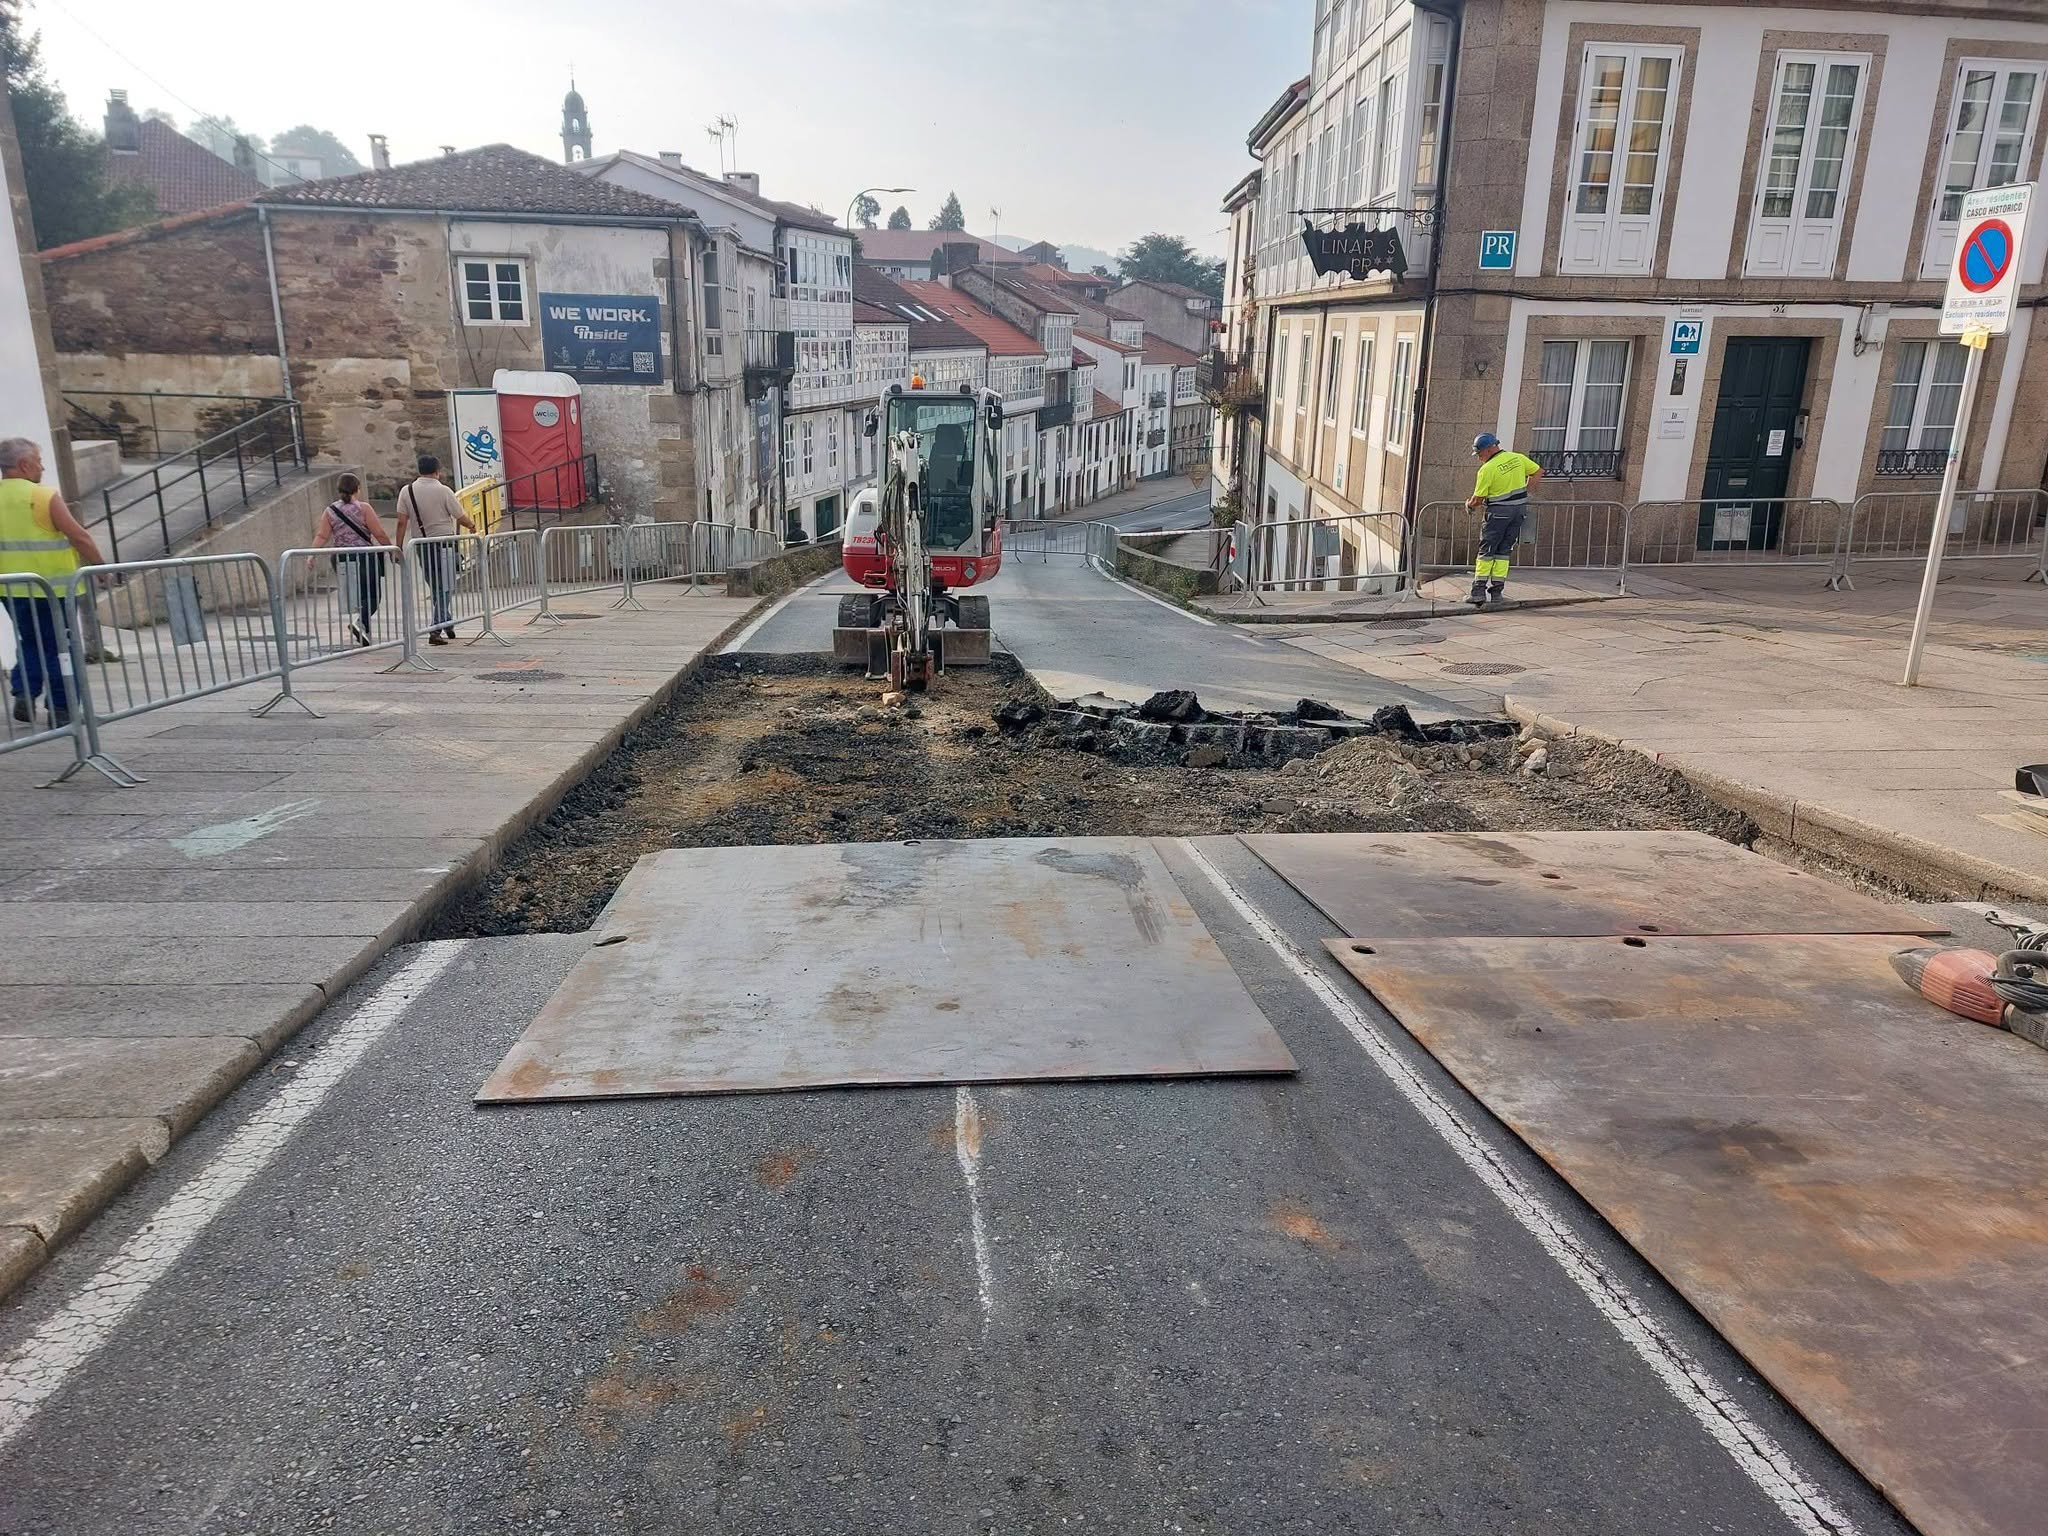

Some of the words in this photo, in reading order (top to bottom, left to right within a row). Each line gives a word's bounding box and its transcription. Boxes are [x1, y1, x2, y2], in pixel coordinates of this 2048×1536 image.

[1967, 207, 1987, 217] CASCO
[1485, 236, 1510, 254] PR
[549, 306, 581, 320] WE
[586, 307, 651, 322] WORK.
